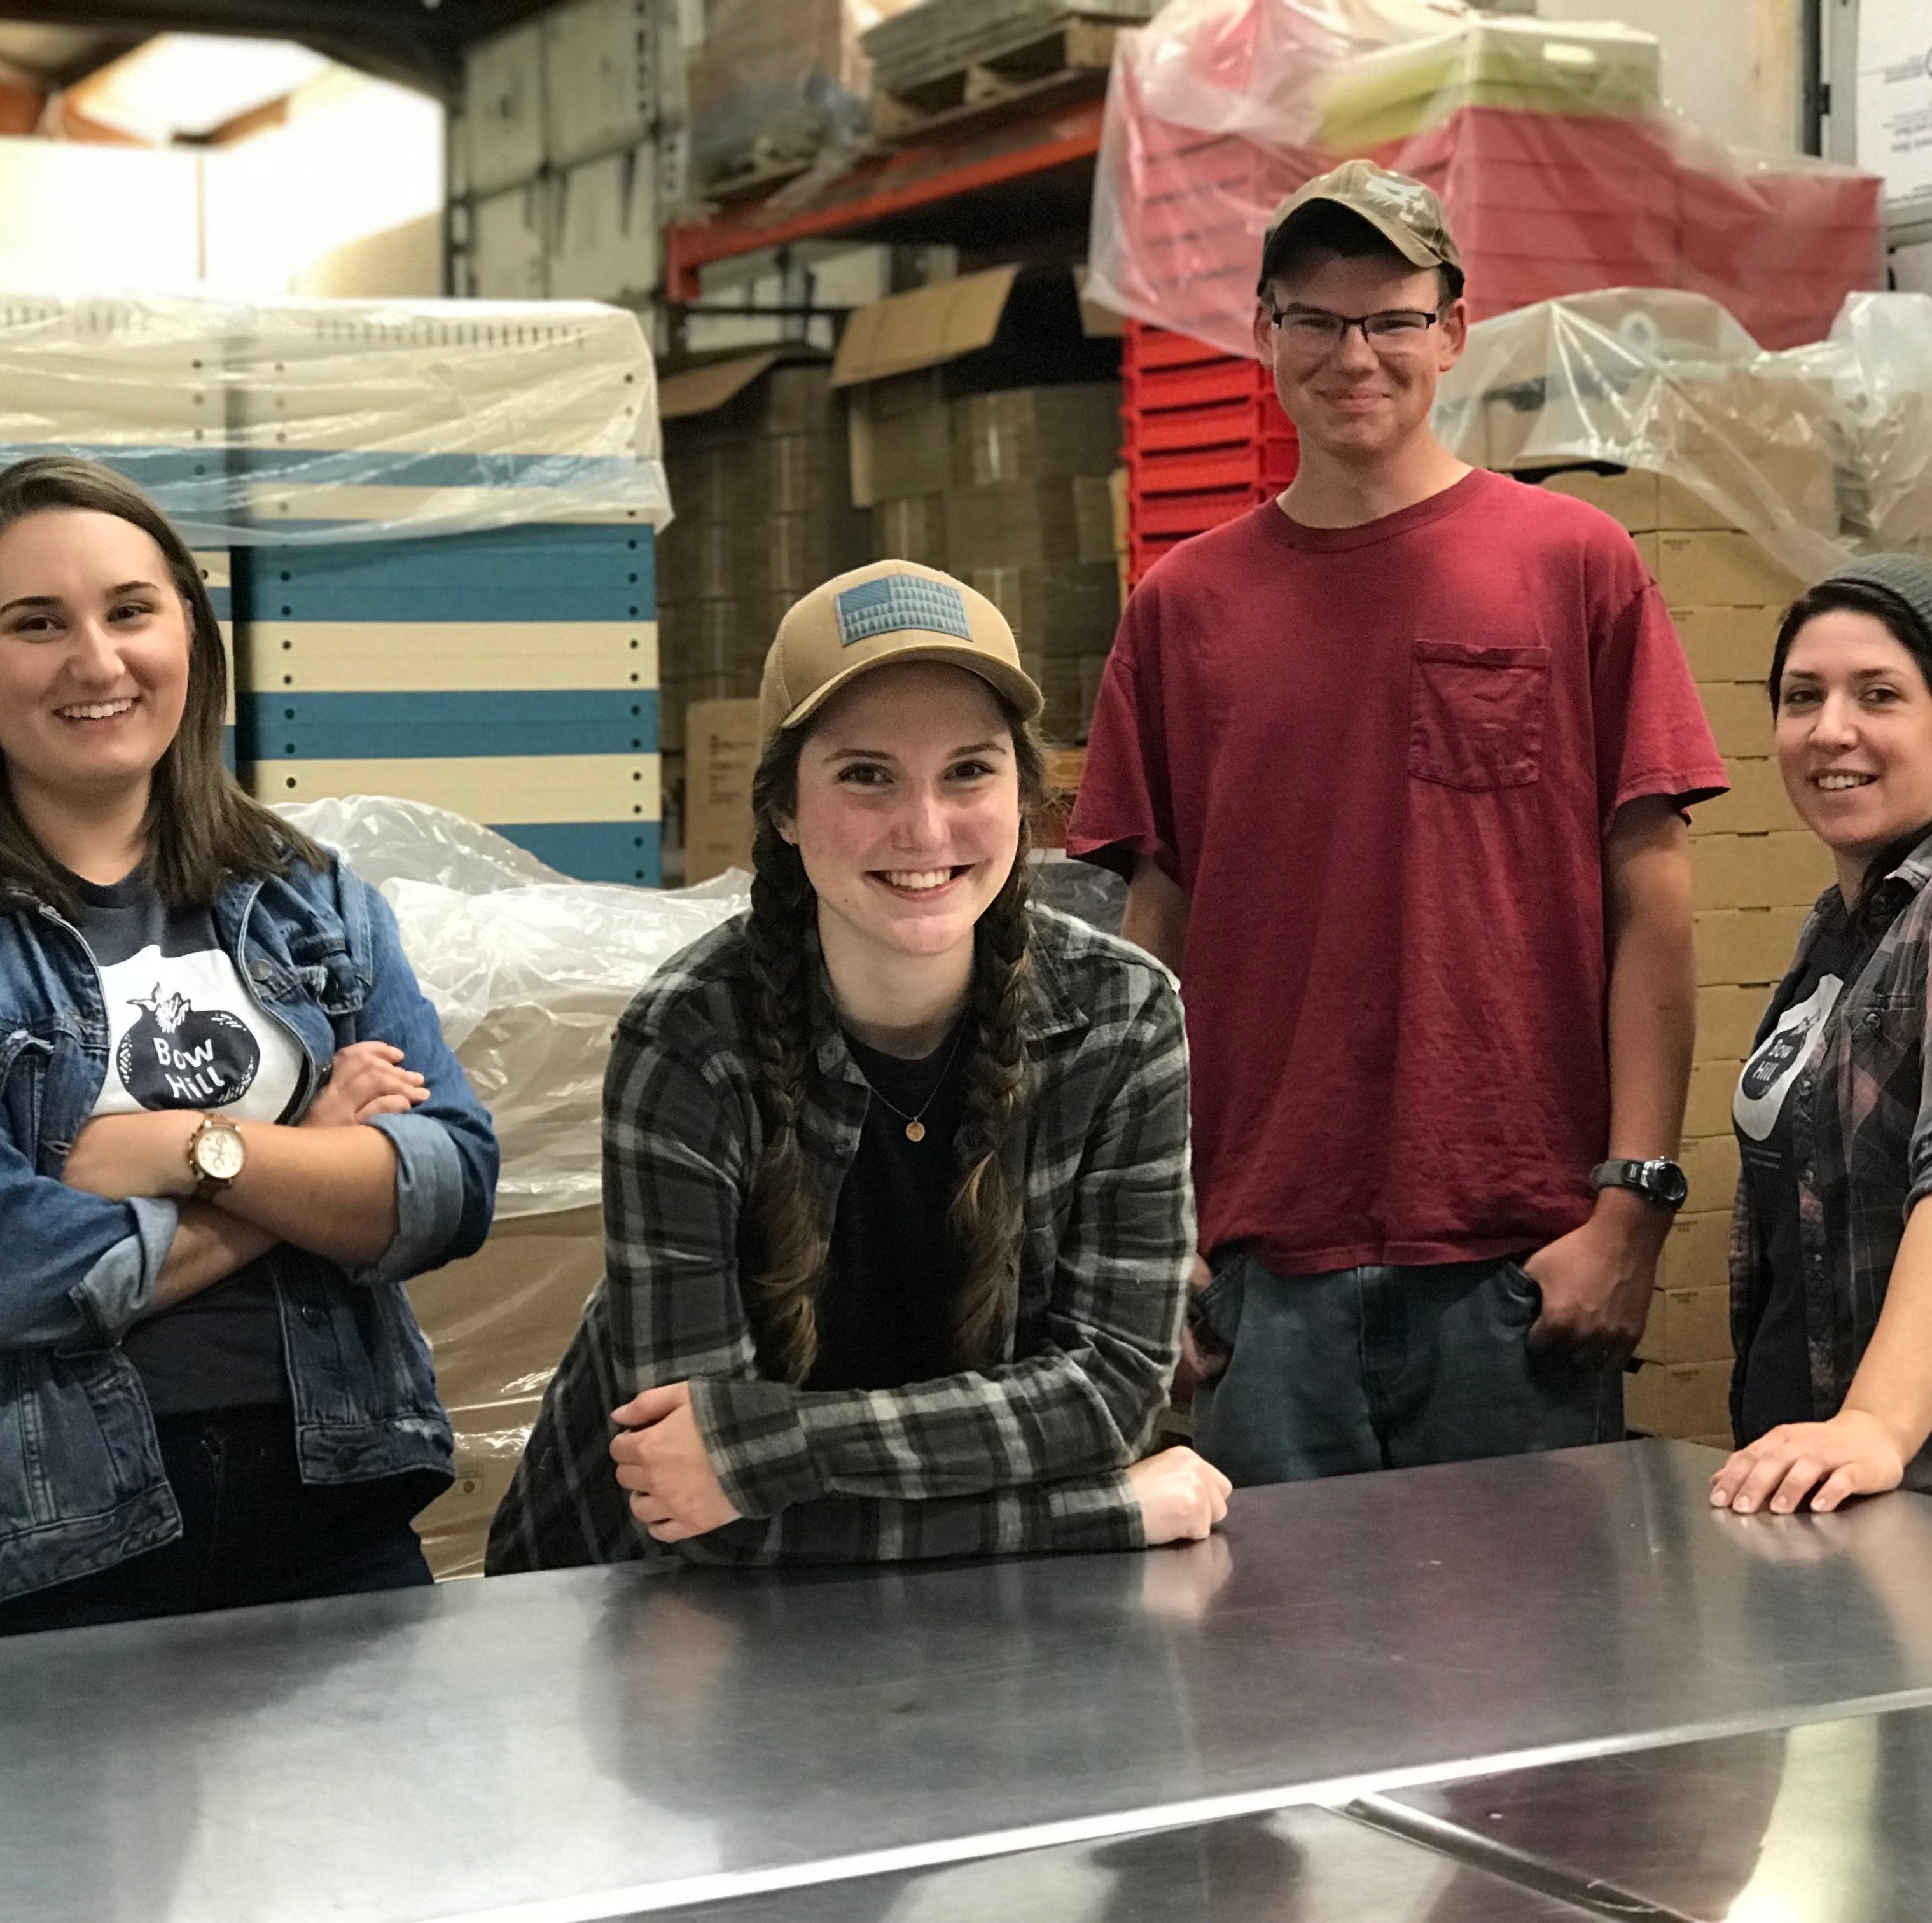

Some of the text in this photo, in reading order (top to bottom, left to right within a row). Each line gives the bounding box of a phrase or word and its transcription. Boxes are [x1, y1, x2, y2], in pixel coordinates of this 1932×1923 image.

[153, 1038, 213, 1070] Bow
[165, 1066, 225, 1099] Hill
[1752, 1060, 1780, 1081] Hill
